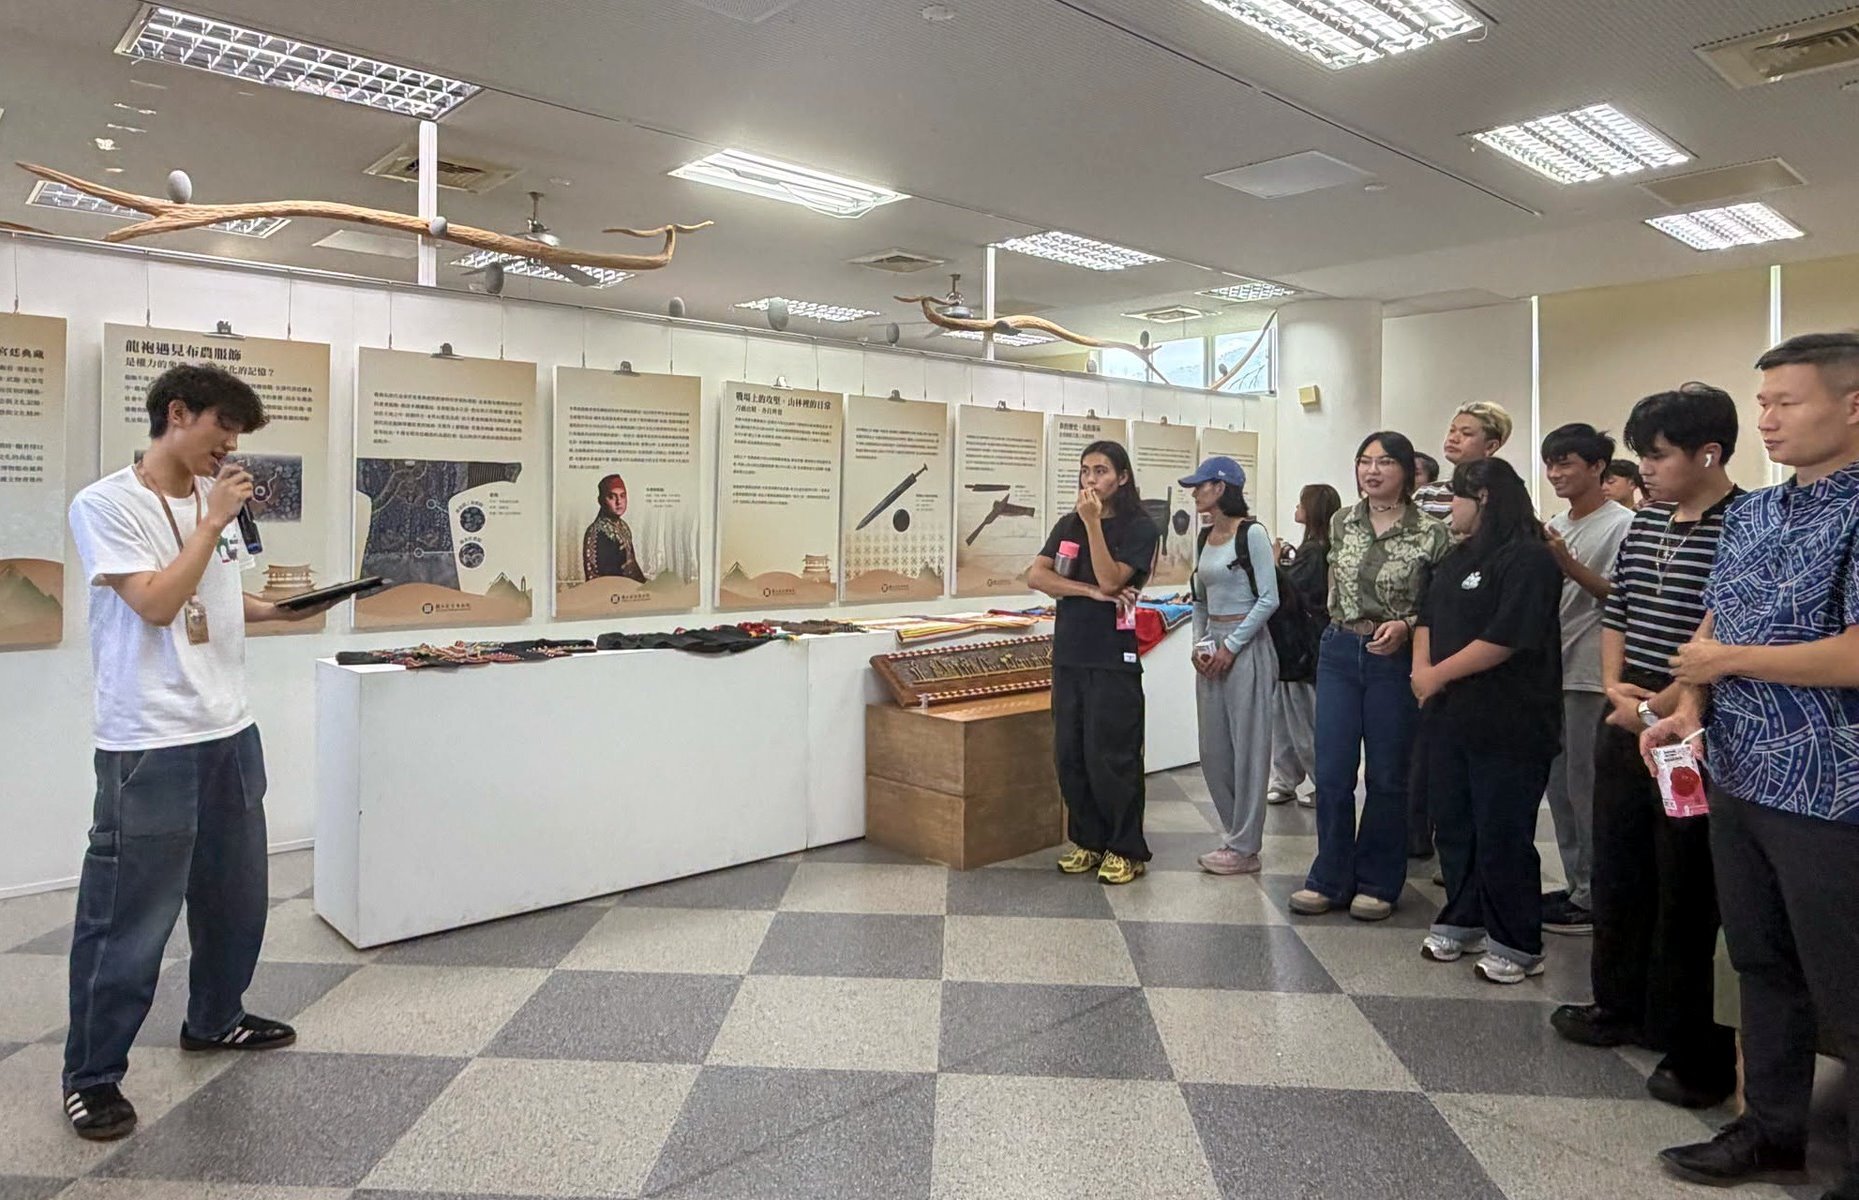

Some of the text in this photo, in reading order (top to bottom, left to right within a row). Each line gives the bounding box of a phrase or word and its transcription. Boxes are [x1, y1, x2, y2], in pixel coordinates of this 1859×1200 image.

[126, 339, 241, 361] 龍袍遇見布農服飾
